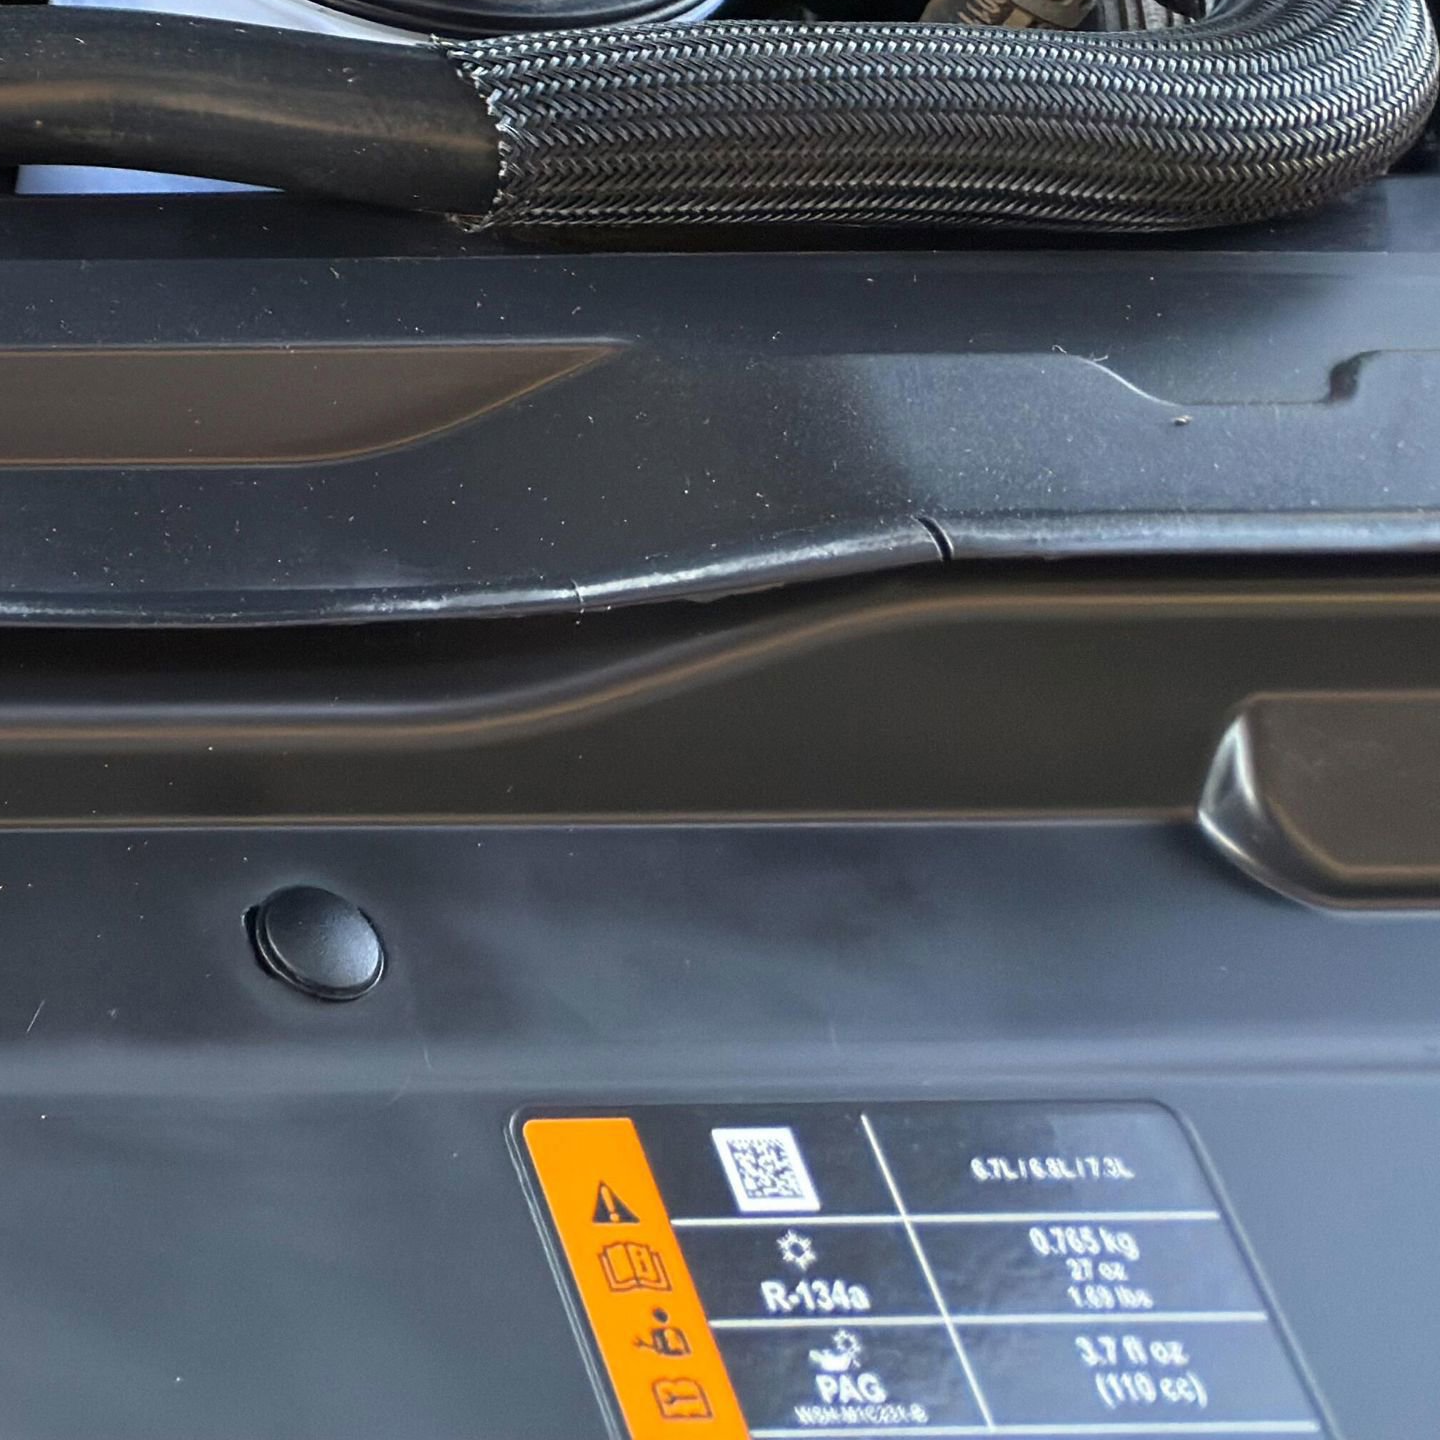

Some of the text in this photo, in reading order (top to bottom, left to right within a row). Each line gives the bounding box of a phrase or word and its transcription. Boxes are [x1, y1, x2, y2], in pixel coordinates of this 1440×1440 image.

[1029, 1226, 1141, 1262] 0.765 kg
[1097, 1262, 1129, 1282] oz
[760, 1279, 872, 1313] R-134a
[1114, 1284, 1155, 1310] lbs
[1075, 1334, 1118, 1367] 3.7
[1149, 1340, 1191, 1367] oz
[815, 1372, 888, 1405] PAG
[1095, 1371, 1209, 1409] (110 cc)
